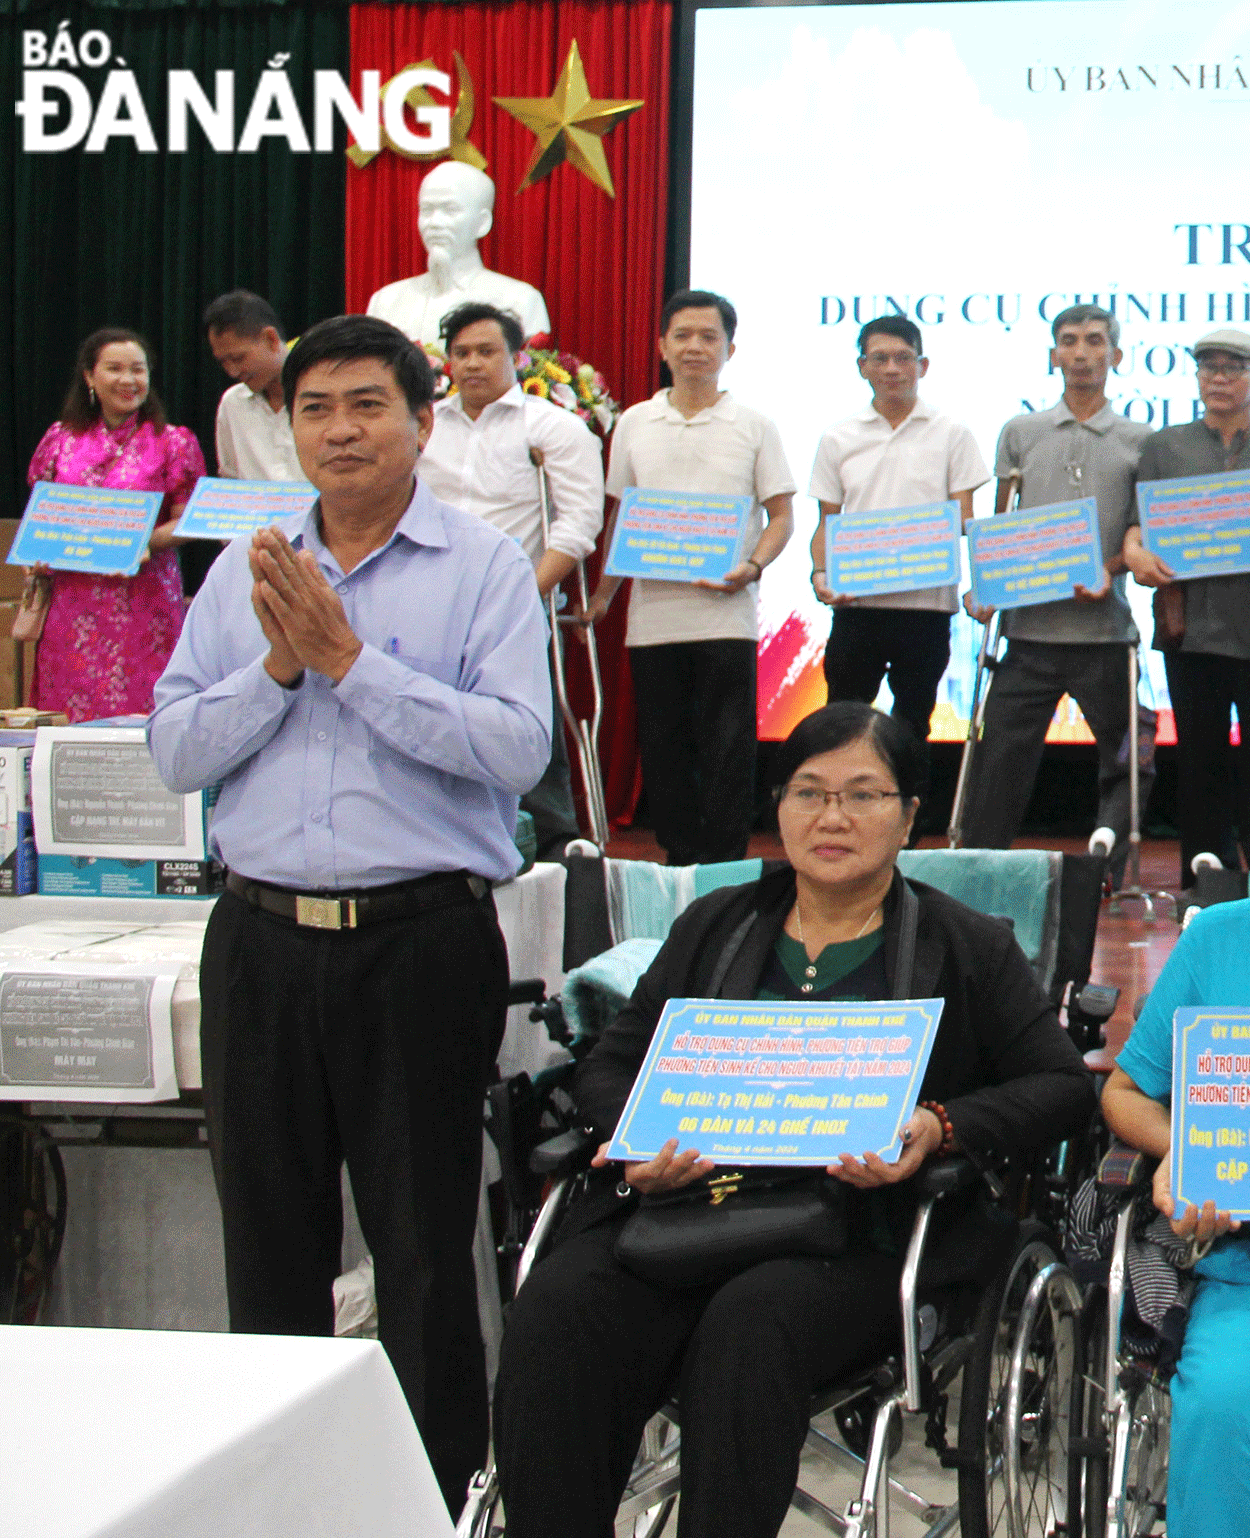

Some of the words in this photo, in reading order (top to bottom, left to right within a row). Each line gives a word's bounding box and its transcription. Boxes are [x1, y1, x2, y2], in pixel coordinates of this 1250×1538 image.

[1024, 58, 1077, 93] ỦY
[1084, 64, 1159, 92] BAN
[961, 292, 1021, 332] CỤ
[695, 1010, 711, 1024] ỦY
[713, 1014, 739, 1025] BAN
[741, 1012, 775, 1026] NHÂN
[777, 1012, 803, 1026] DÂN
[805, 1013, 838, 1028] QUẬN
[841, 1015, 880, 1027] THANH
[882, 1013, 906, 1026] KHÊ
[1211, 1022, 1228, 1039] ỦY
[672, 1030, 691, 1050] HỖ
[688, 1035, 710, 1055] TRỢ
[706, 1036, 735, 1056] DỤNG
[734, 1037, 750, 1056] CỤ
[749, 1034, 779, 1054] CHỈNH
[806, 1036, 846, 1054] PHƯƠNG
[845, 1035, 869, 1057] TIỆN
[868, 1036, 889, 1056] TRỢ
[887, 1034, 912, 1054] GIÚP
[655, 1056, 697, 1074] PHƯƠNG
[695, 1056, 719, 1078] TIỆN
[718, 1059, 744, 1076] SINH
[741, 1056, 762, 1076] KẾ
[757, 1060, 779, 1077] CHO
[777, 1057, 809, 1077] NGƯỜI
[807, 1057, 845, 1077] KHUYẾT
[844, 1058, 864, 1080] TẬT
[862, 1057, 888, 1077] NĂM
[885, 1060, 912, 1077] 2024
[1197, 1048, 1213, 1075] HỖ
[1214, 1053, 1234, 1079] TRỢ
[661, 1088, 685, 1107] Ông
[685, 1091, 715, 1107] (Bà):
[717, 1092, 732, 1110] Tạ
[734, 1092, 753, 1110] Thị
[783, 1093, 829, 1110] Phường
[831, 1093, 852, 1108] Tân
[854, 1093, 889, 1108] Chính
[1188, 1083, 1230, 1105] PHƯƠNG
[678, 1117, 698, 1133] 06
[700, 1115, 733, 1133] BÀN
[735, 1116, 755, 1134] VÀ
[757, 1119, 776, 1135] 24
[779, 1115, 813, 1135] GHẾ
[811, 1119, 849, 1135] INOX
[1189, 1124, 1212, 1148] Ông
[1216, 1127, 1246, 1147] (Bà):
[713, 1144, 741, 1154] Tháng
[775, 1145, 798, 1154] 2024
[1216, 1158, 1248, 1185] CẶP
